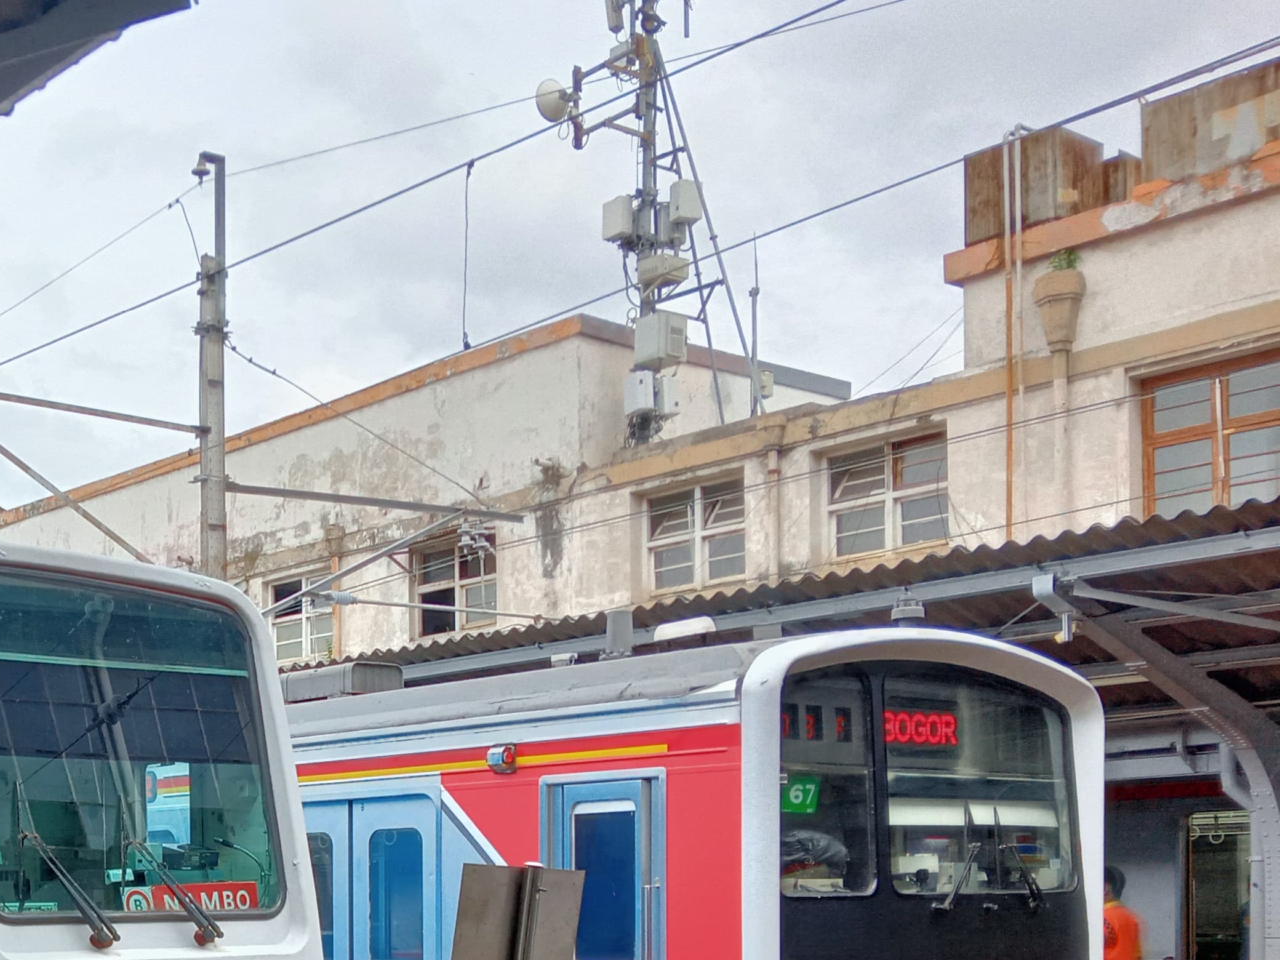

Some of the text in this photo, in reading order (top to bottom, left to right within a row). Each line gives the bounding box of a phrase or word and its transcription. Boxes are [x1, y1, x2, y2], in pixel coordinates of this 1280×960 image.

[883, 710, 958, 745] BOGOR
[789, 784, 816, 804] 67
[163, 889, 250, 910] NMBO
